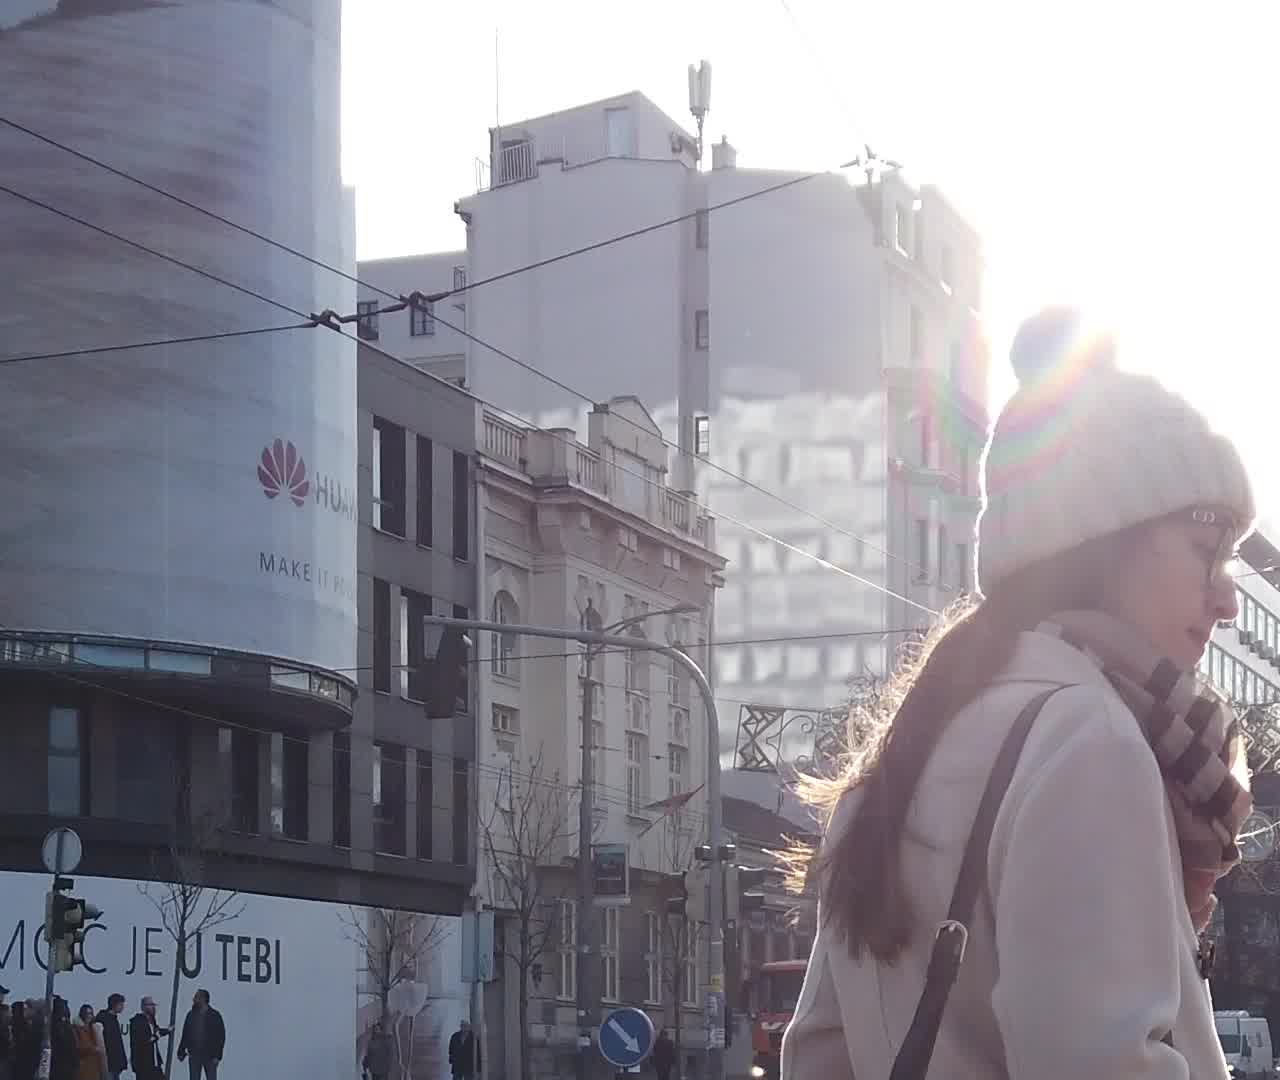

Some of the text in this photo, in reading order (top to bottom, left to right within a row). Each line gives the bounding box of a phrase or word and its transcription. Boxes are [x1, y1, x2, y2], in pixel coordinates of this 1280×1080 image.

[259, 551, 312, 582] MAKE
[125, 926, 163, 976] JE
[215, 933, 281, 985] TEBI
